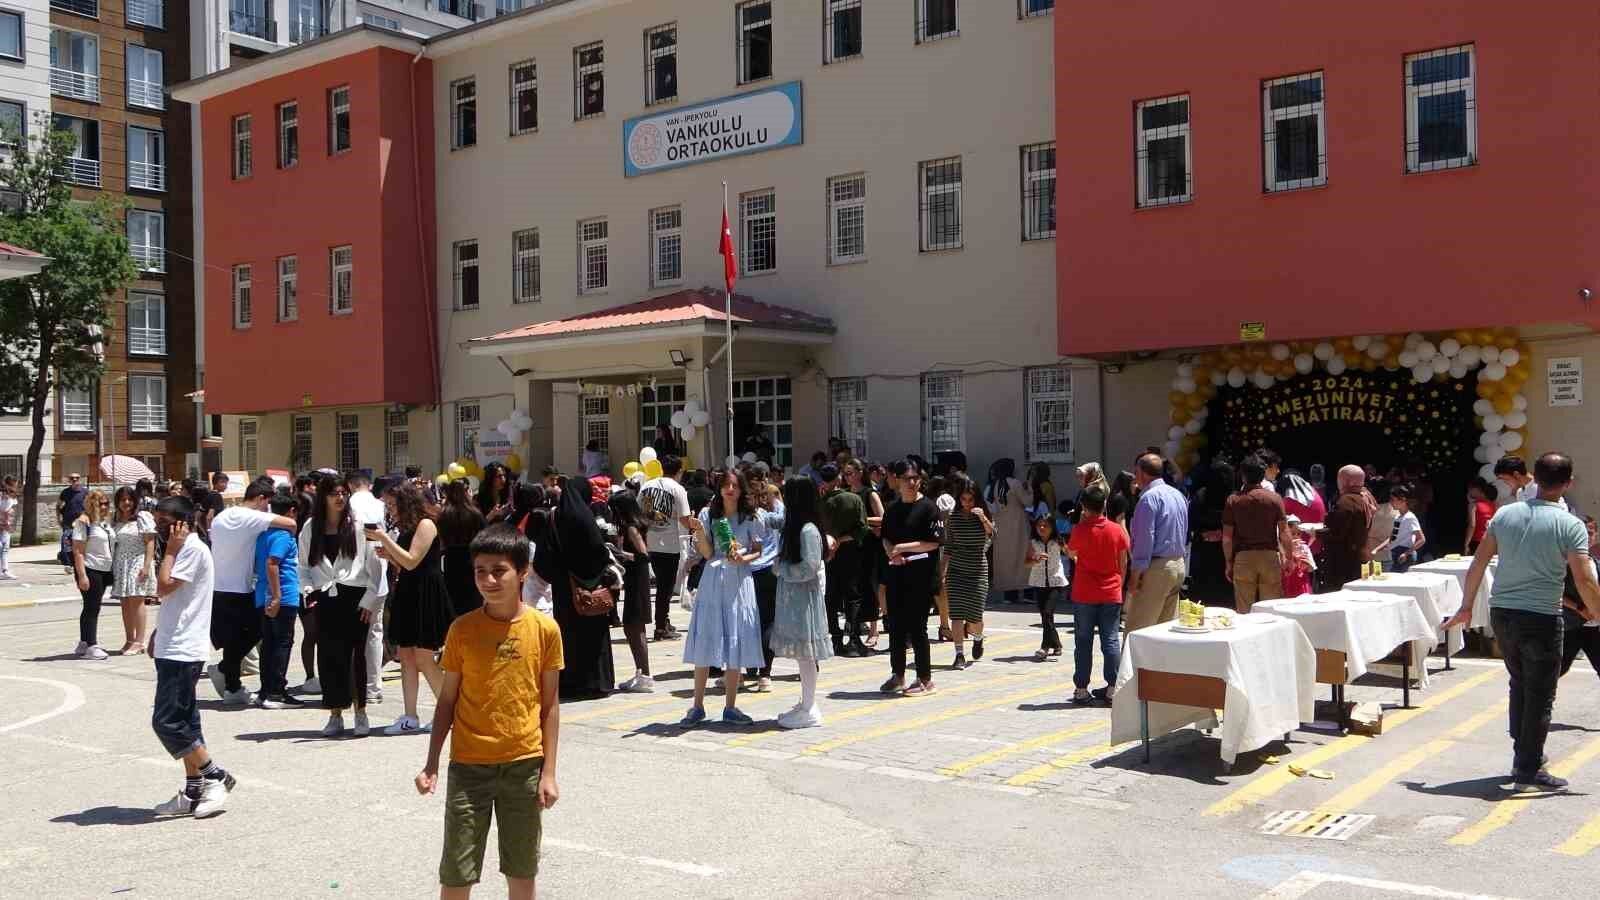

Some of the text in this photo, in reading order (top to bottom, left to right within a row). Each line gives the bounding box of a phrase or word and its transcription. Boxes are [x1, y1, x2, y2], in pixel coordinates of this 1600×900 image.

[666, 117, 679, 126] VAN
[667, 115, 742, 144] VANKULU
[667, 127, 768, 161] ORTAOKULU
[1312, 376, 1364, 391] 2024
[1274, 387, 1395, 416] MEZUNİYET
[1291, 406, 1384, 427] HATIRASI
